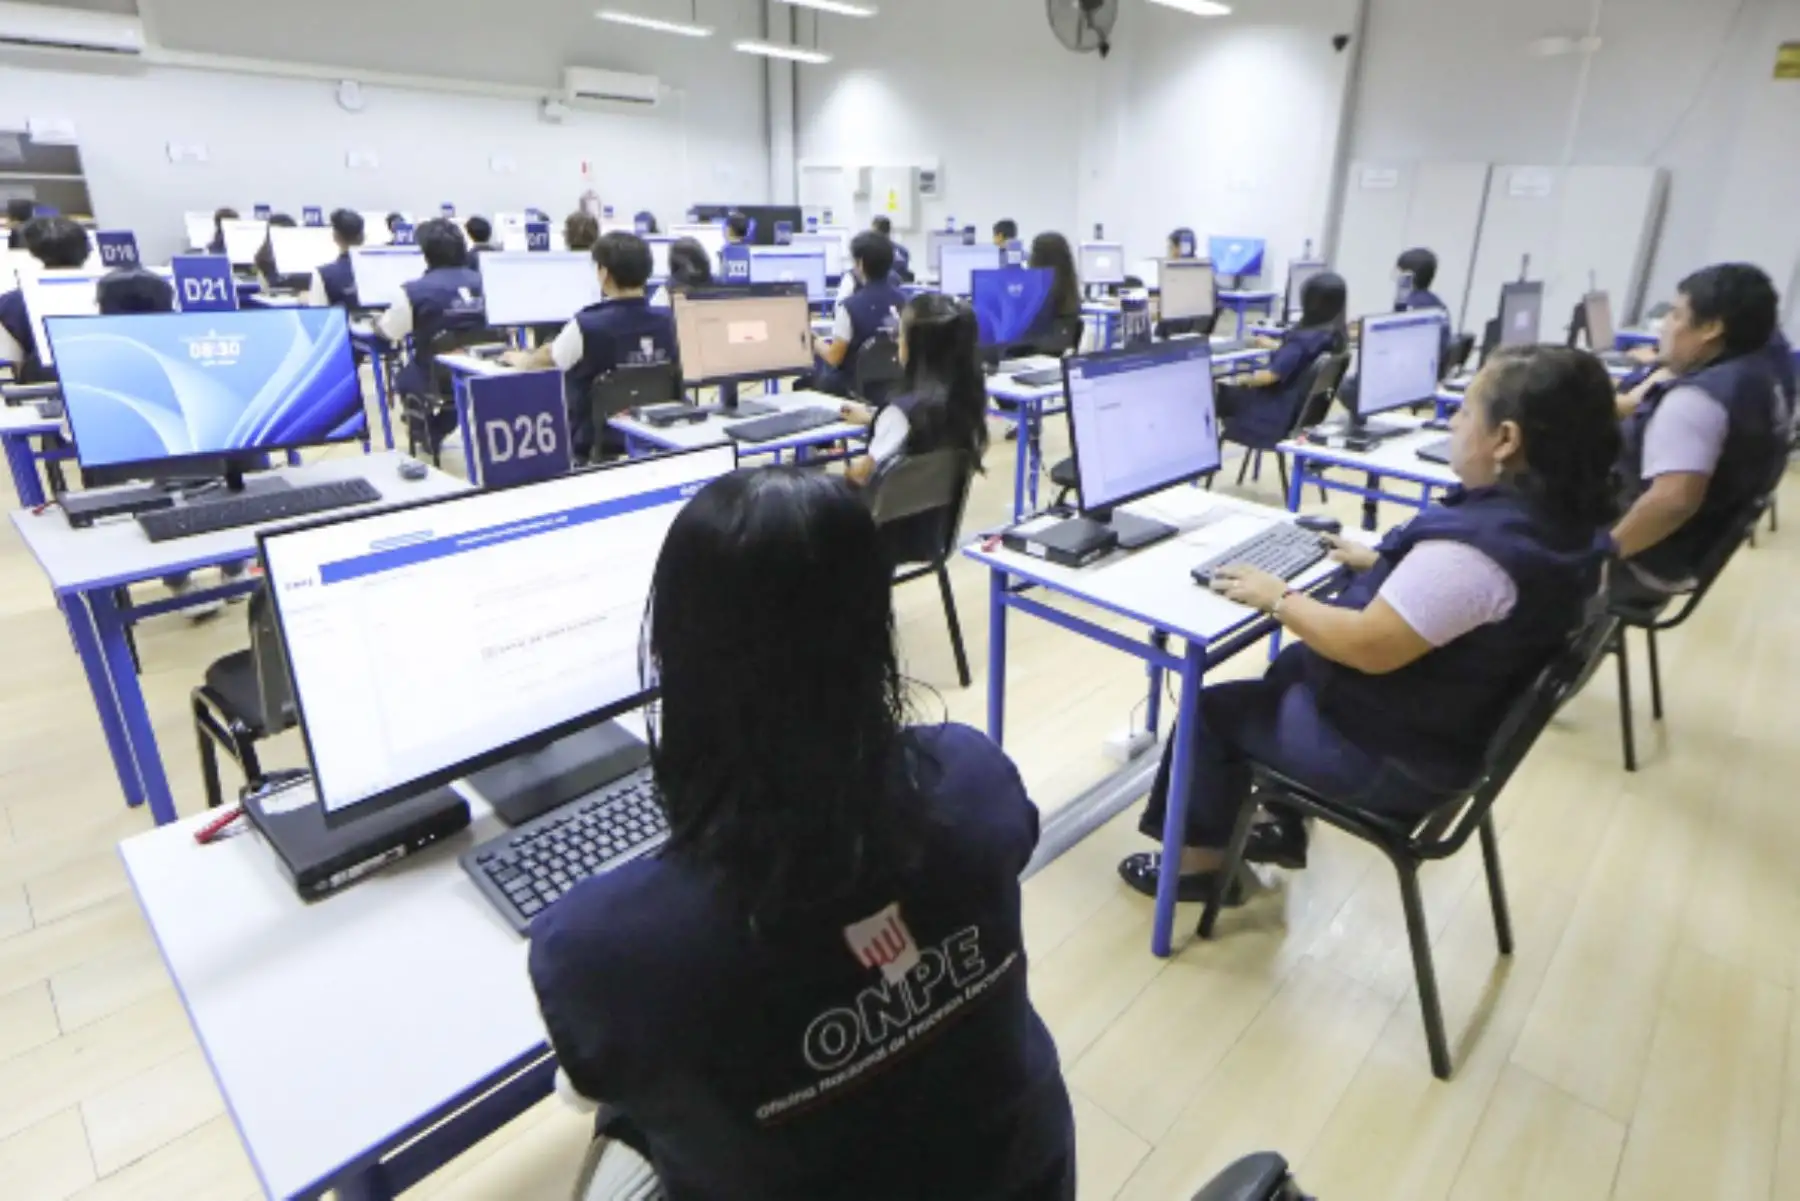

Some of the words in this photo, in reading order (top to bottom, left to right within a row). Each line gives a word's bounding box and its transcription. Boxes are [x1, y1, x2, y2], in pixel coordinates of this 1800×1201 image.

[183, 277, 229, 303] D21
[485, 412, 557, 464] D26
[803, 924, 986, 1071] ONPE
